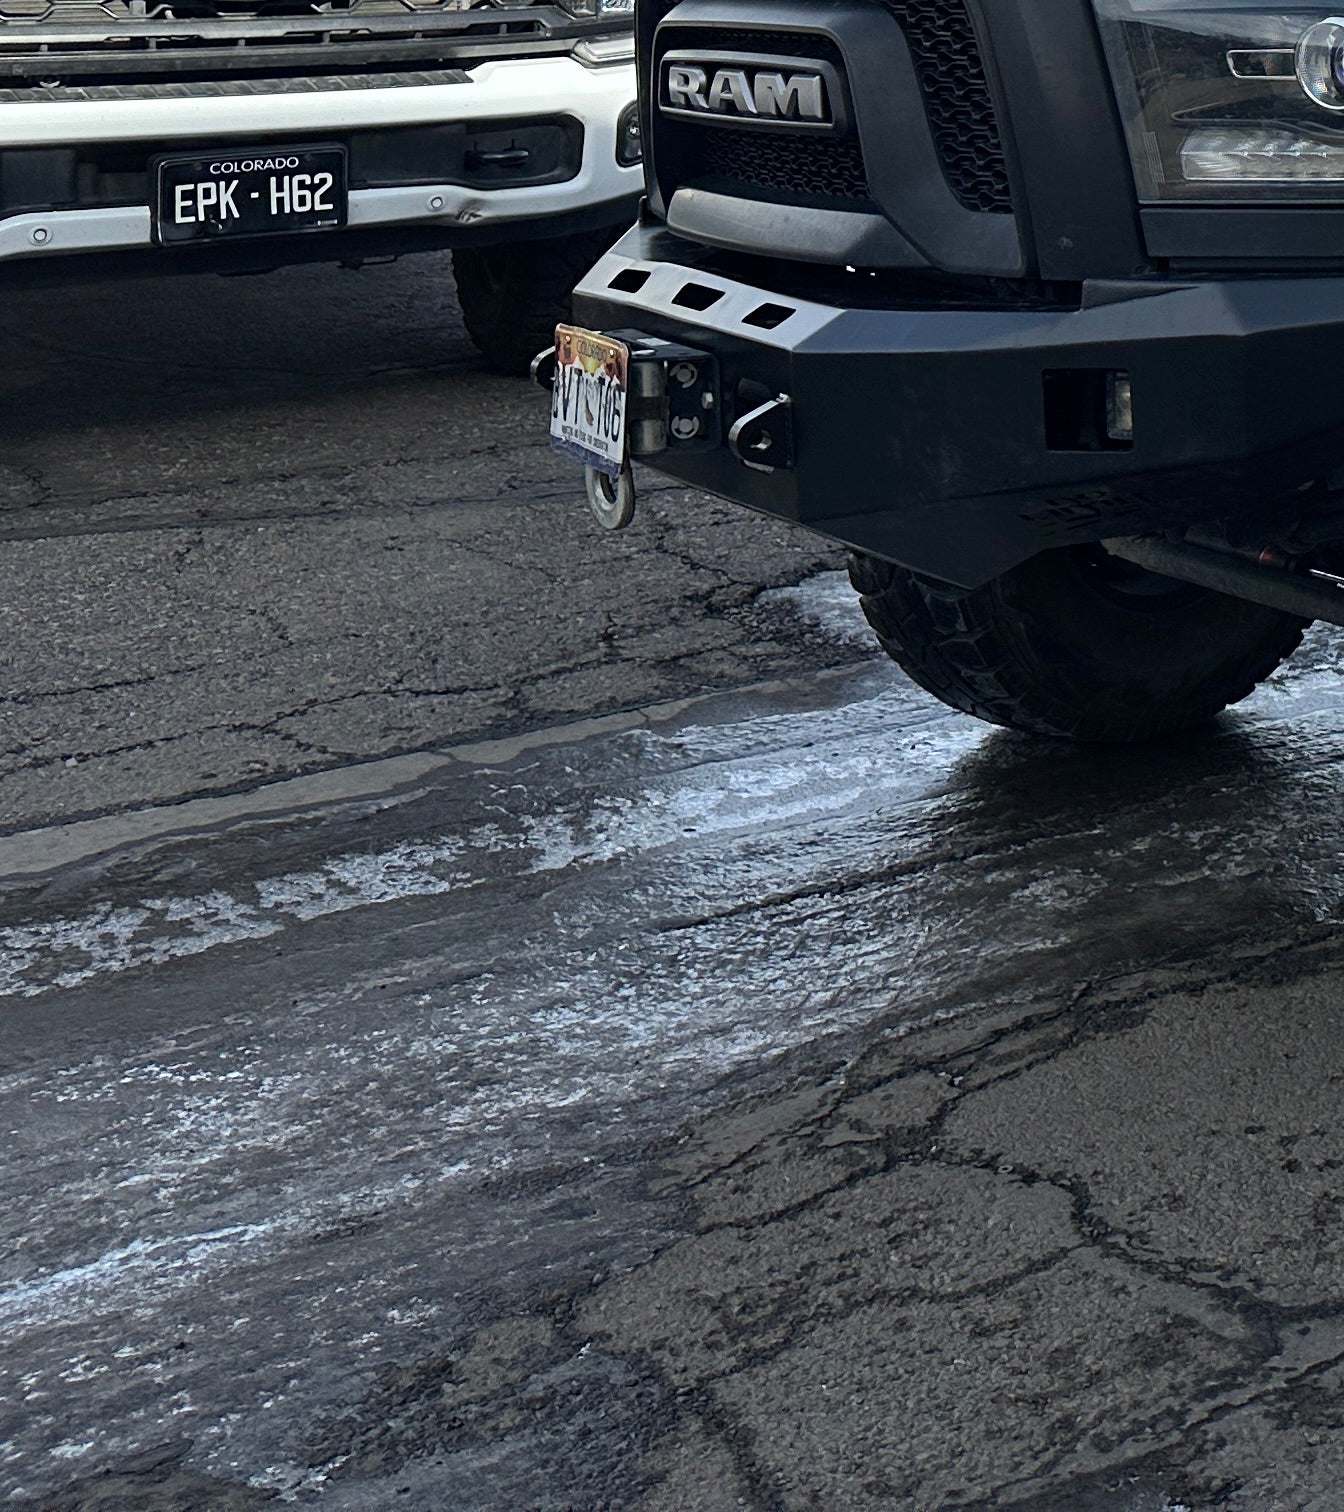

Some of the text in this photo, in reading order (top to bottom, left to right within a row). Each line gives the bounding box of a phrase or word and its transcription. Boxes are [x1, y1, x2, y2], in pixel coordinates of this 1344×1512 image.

[668, 64, 823, 119] RAM
[209, 156, 300, 175] COLORADO
[174, 179, 241, 224] EPK
[269, 172, 334, 215] H62
